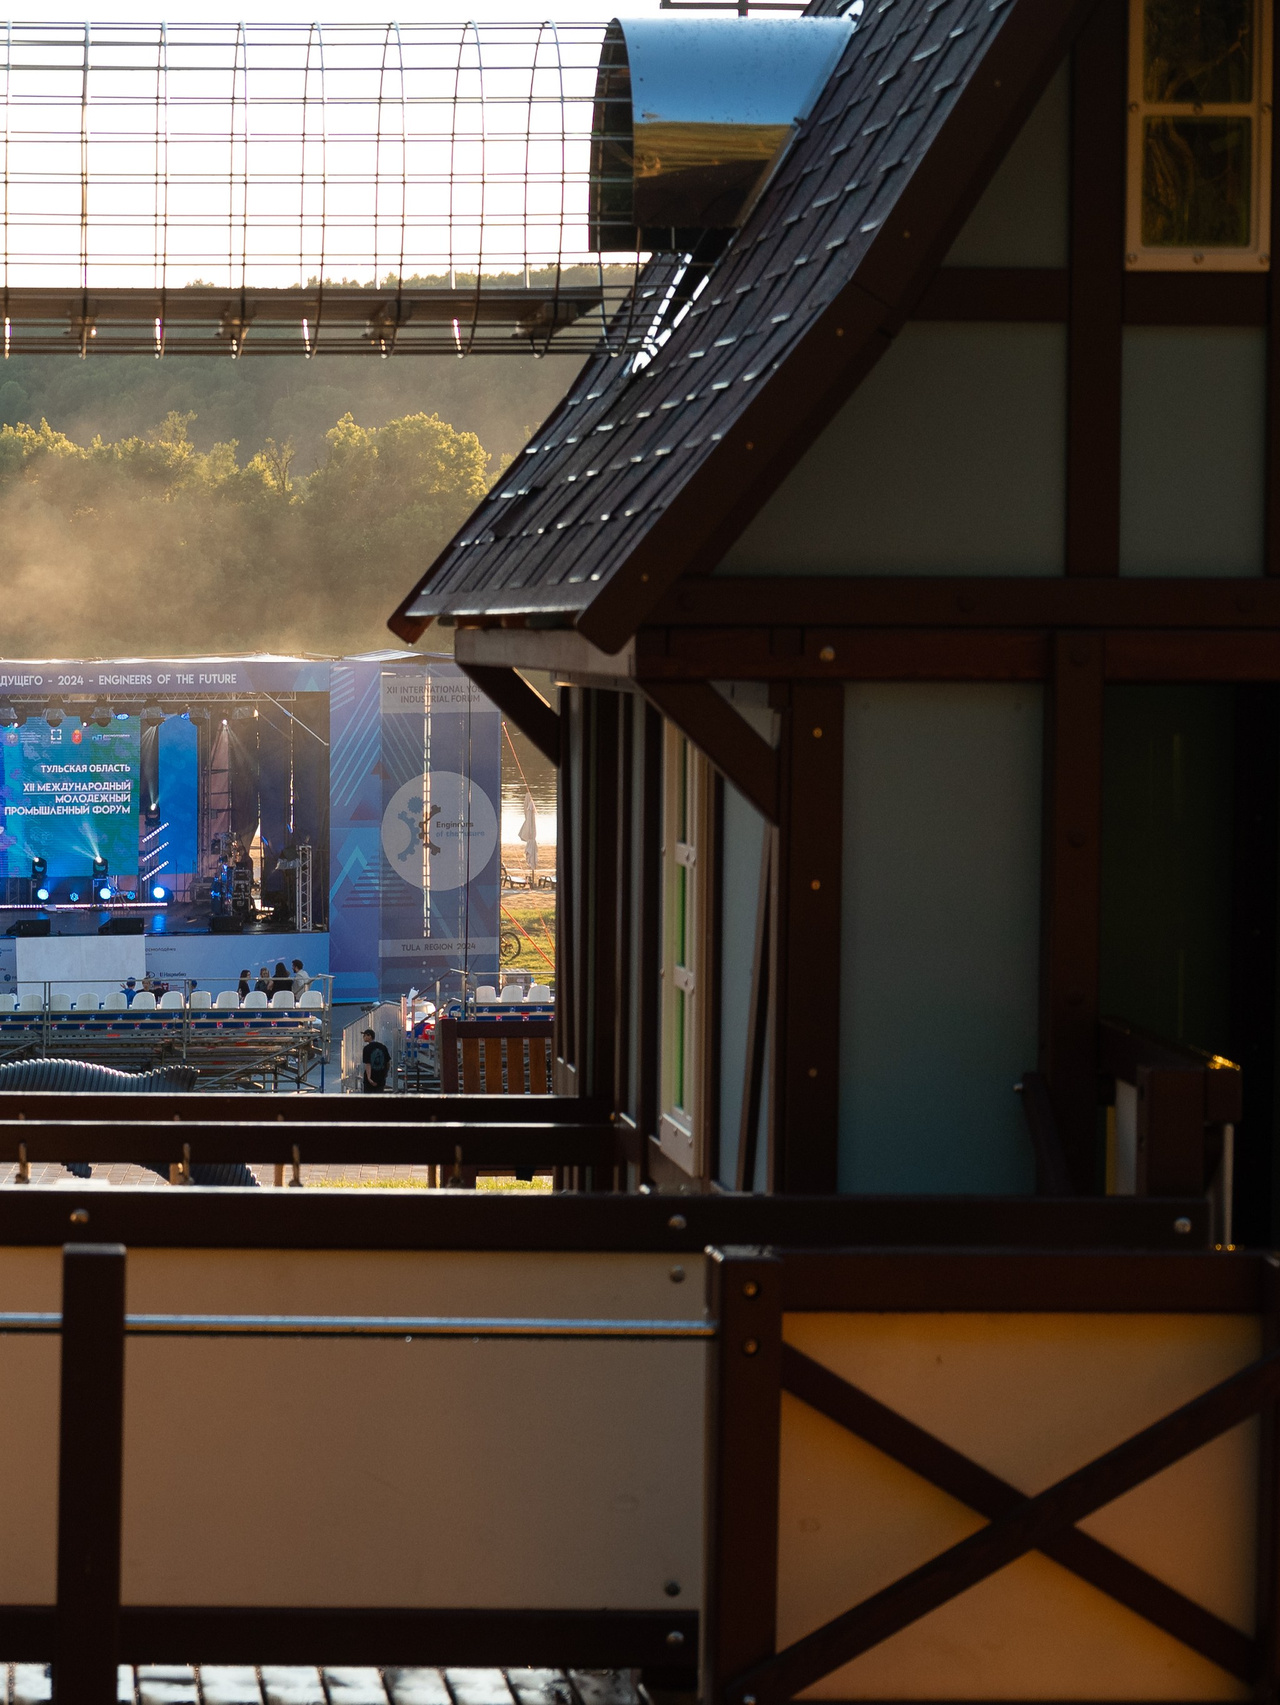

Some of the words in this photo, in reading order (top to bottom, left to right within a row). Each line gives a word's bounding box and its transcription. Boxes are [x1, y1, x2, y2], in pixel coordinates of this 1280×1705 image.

[57, 675, 84, 686] 2024
[98, 674, 153, 685] ENGINEERS
[157, 674, 171, 685] OF
[176, 674, 194, 684] THE
[199, 673, 237, 684] FUTURE
[41, 764, 87, 773] ТУЛЬСКАЯ
[89, 764, 131, 773] ОБЛАСТЬ
[23, 783, 35, 792] XII
[37, 780, 131, 792] МЕЖДУНАРОДНЫЙ
[55, 793, 131, 803] МОЛОДЕЖНЫЙ
[4, 804, 90, 815] ПРОМЫШЛЕННЫЙ
[92, 804, 131, 814] ФОРУМ
[424, 943, 453, 951] REGION
